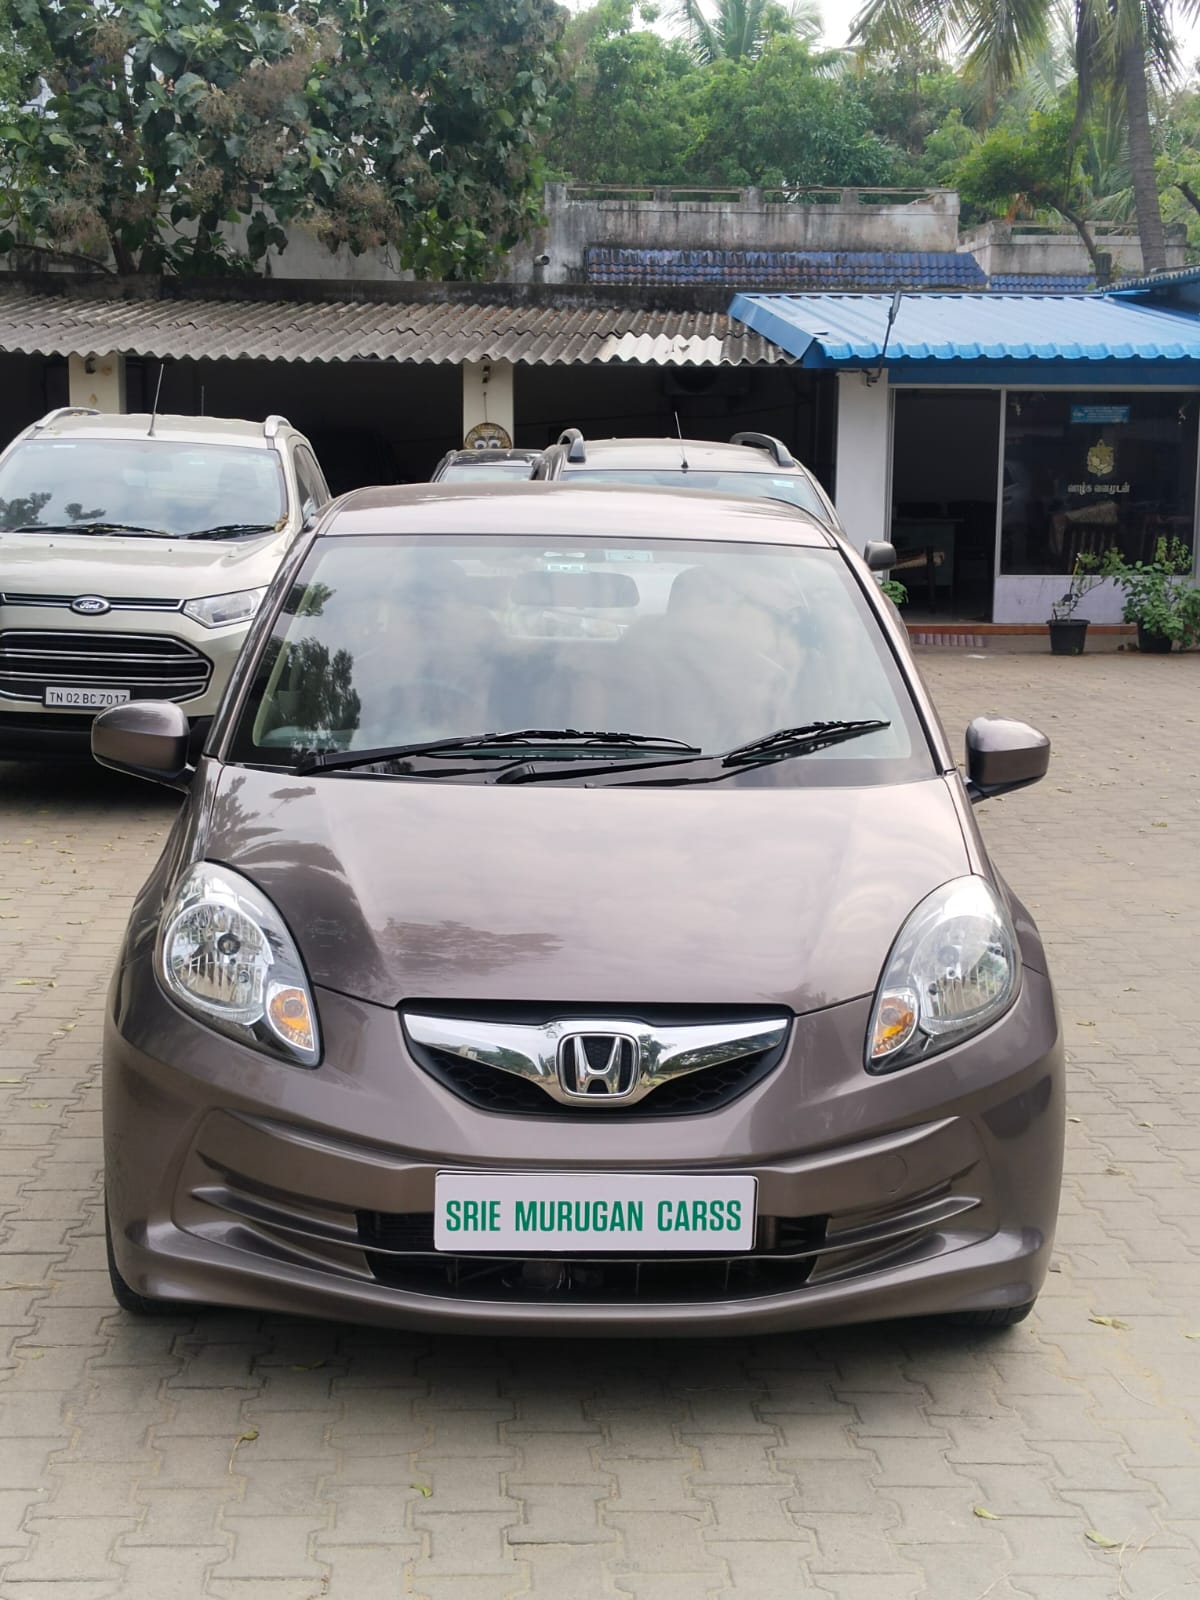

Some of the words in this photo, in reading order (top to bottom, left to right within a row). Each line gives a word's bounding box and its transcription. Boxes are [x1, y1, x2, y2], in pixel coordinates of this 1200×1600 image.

[50, 692, 63, 703] TN
[66, 693, 80, 704] 02
[82, 694, 97, 705] BC
[446, 1200, 501, 1232] SRIE
[514, 1200, 644, 1232] MURUGAN
[657, 1200, 742, 1232] CARSS
